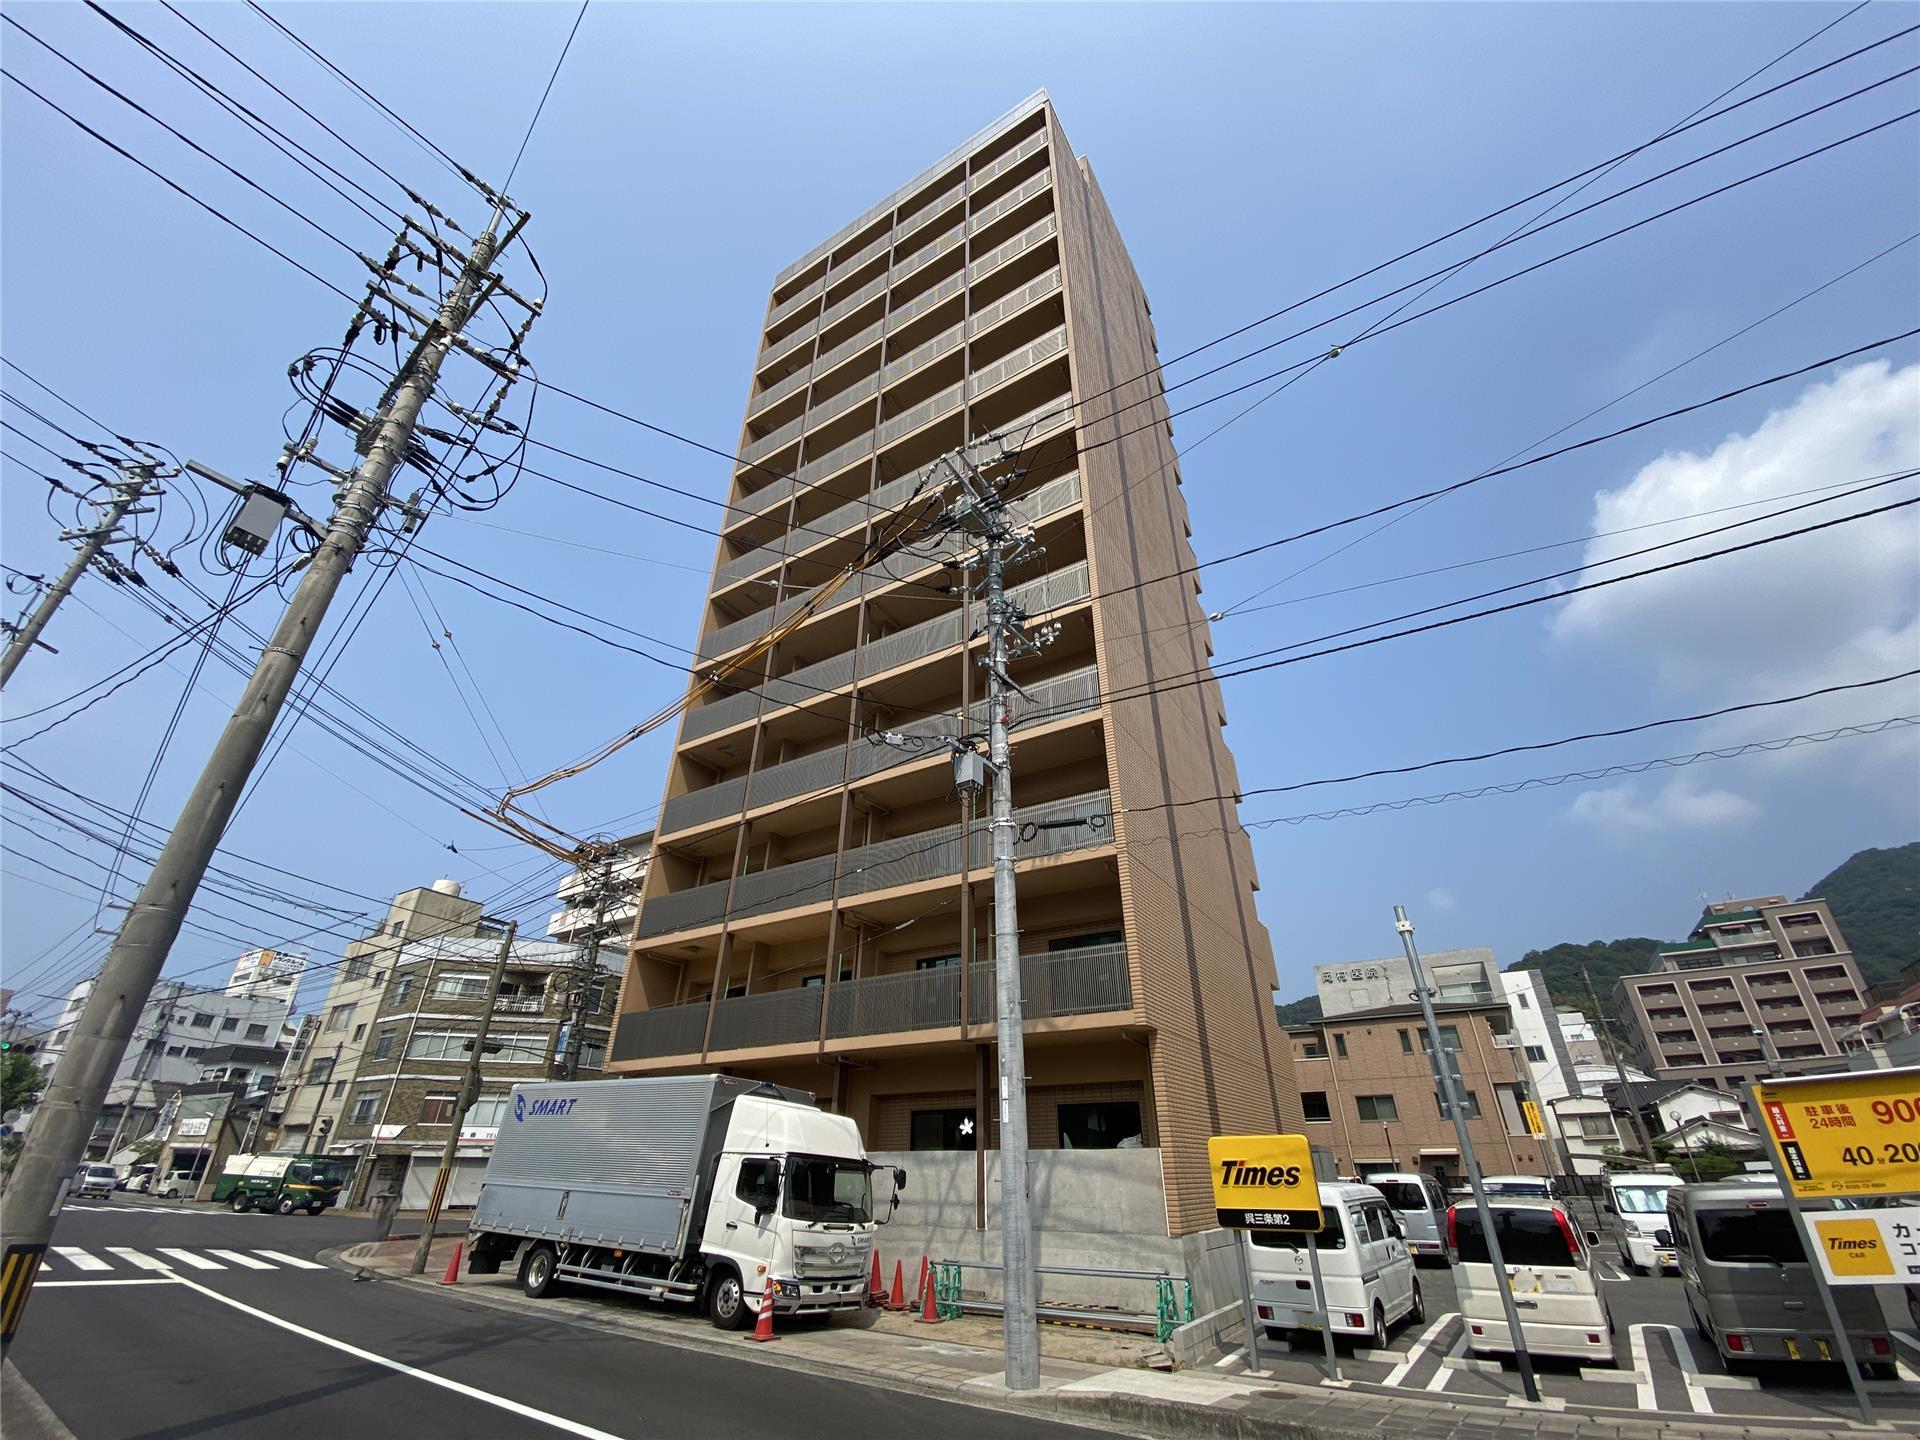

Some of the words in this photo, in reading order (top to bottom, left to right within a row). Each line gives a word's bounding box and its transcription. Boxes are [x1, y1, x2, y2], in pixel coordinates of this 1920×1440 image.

[529, 1098, 578, 1116] SMART
[1804, 1103, 1851, 1117] 駐車後
[1810, 1116, 1856, 1130] 24時間
[1884, 1142, 1920, 1163] 20
[1221, 1160, 1301, 1186] Times
[1244, 1212, 1291, 1226] 呉三条第2
[1892, 1222, 1920, 1238] カ
[1828, 1237, 1878, 1250] Times
[1899, 1243, 1920, 1256] コ
